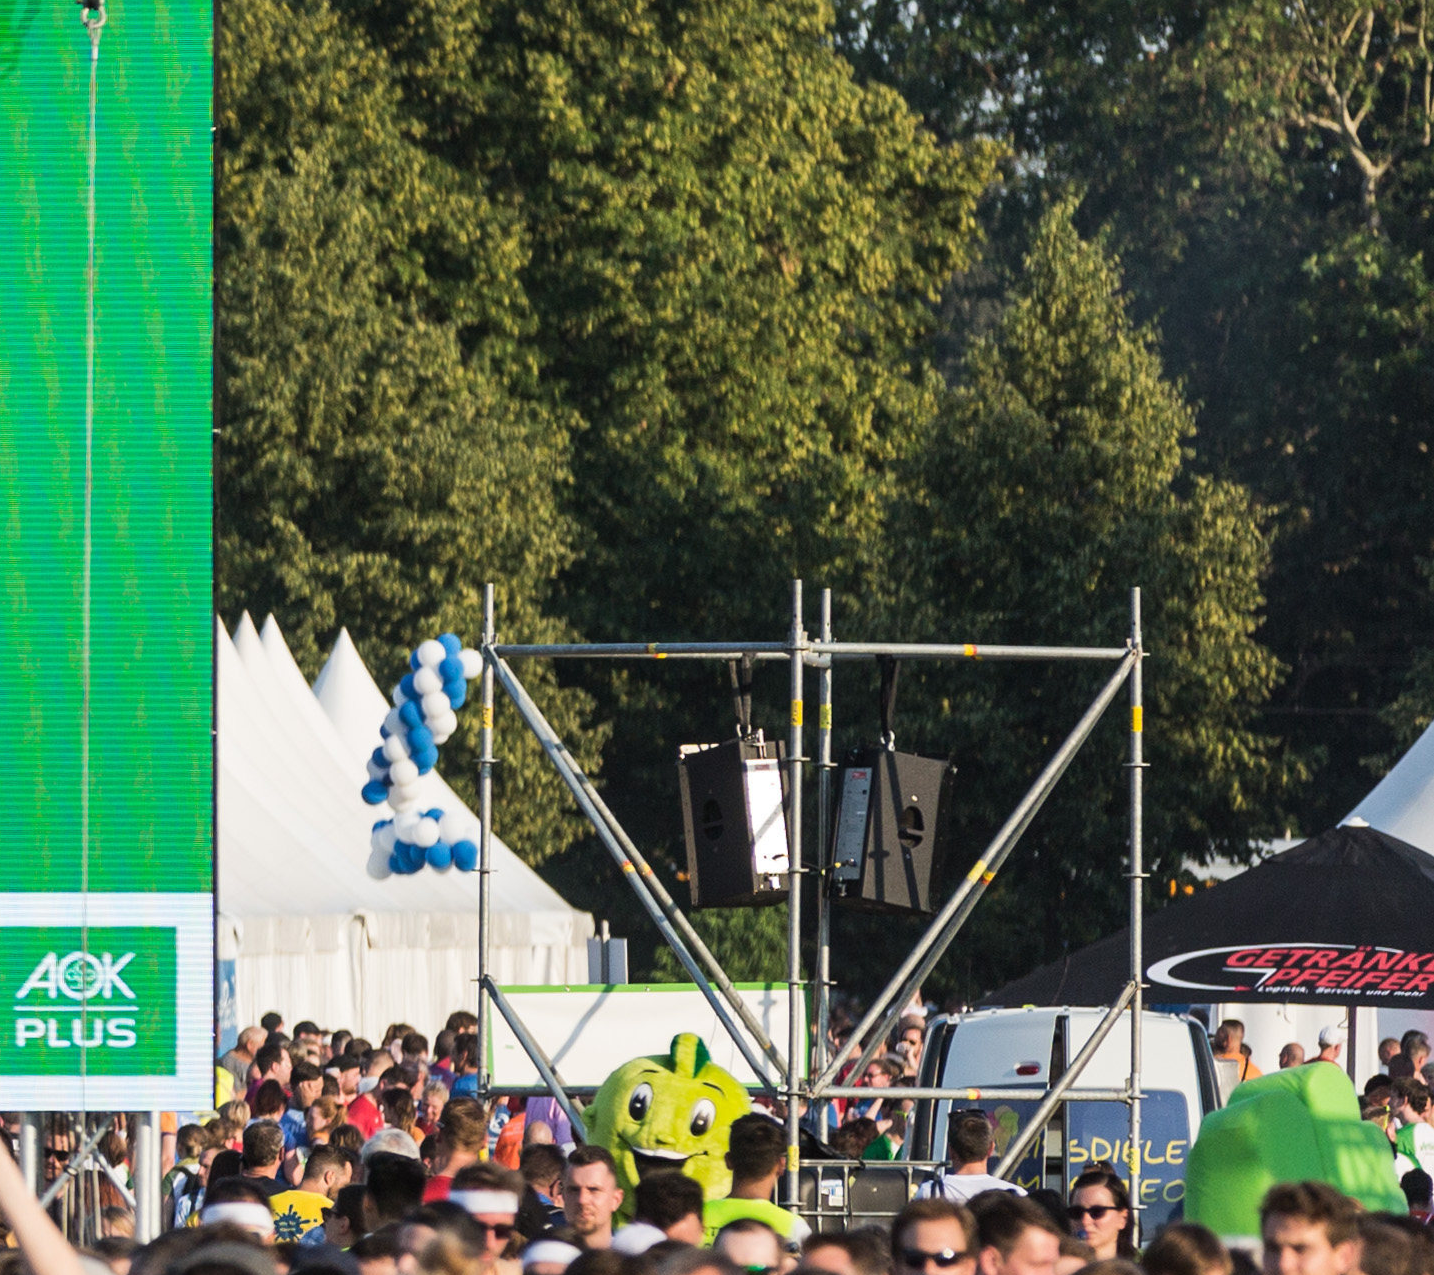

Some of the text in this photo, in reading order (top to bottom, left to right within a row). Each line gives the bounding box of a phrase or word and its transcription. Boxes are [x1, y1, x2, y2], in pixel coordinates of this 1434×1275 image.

[1225, 946, 1434, 973] GETRÄNK
[14, 950, 137, 1001] AOK
[1264, 968, 1434, 992] PFEIFER
[14, 1017, 138, 1049] PLUS
